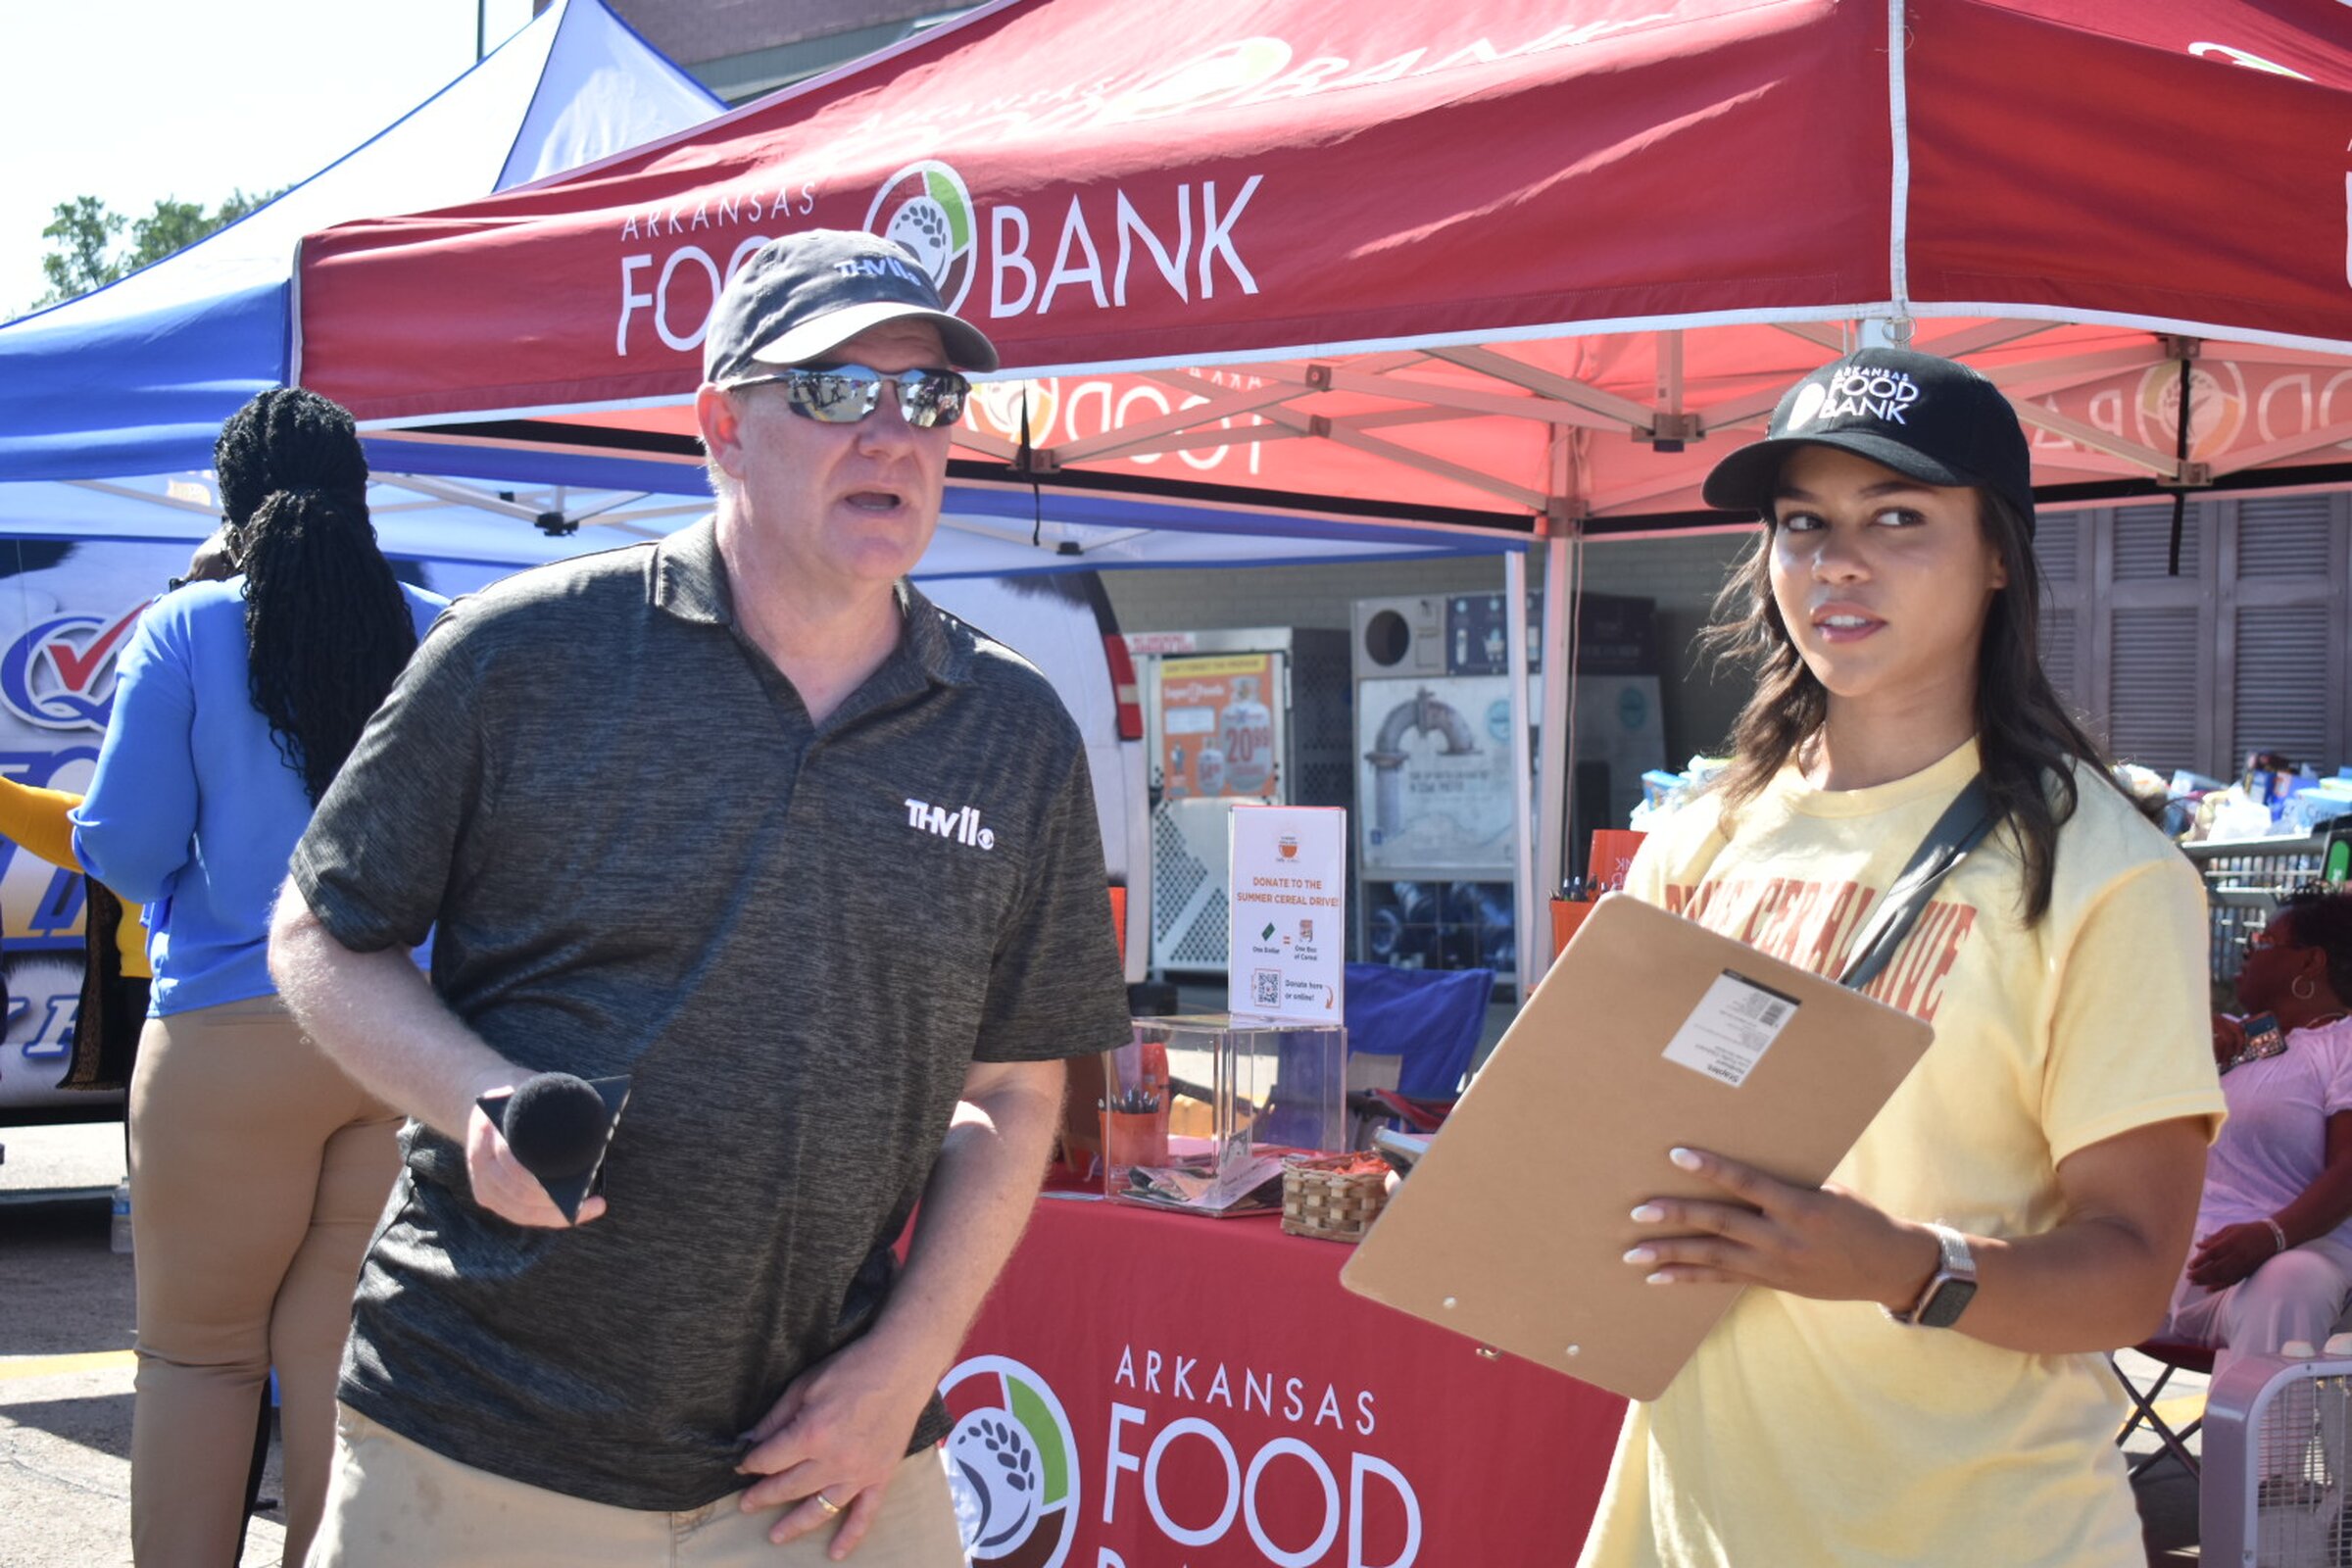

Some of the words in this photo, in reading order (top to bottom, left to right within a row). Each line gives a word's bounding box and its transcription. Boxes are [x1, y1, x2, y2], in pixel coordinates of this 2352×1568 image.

[621, 181, 815, 241] ARKANSAS
[616, 234, 773, 356] FO
[990, 174, 1264, 318] BANK
[1834, 366, 1909, 380] ARKANSAS
[1828, 375, 1919, 403] FOOD
[1819, 397, 1910, 425] BANK
[1253, 877, 1289, 888] DONATE
[1292, 878, 1302, 888] TO
[1304, 880, 1322, 890] THE
[1237, 892, 1273, 903] SUMMER
[1274, 894, 1307, 906] CEREAL
[1309, 896, 1339, 906] DRIVE!
[1285, 980, 1307, 989] Donate
[1309, 981, 1323, 990] here
[1294, 993, 1314, 1002] online!
[1114, 1344, 1375, 1435] ARKANSAS
[1103, 1402, 1421, 1568] FOOD
